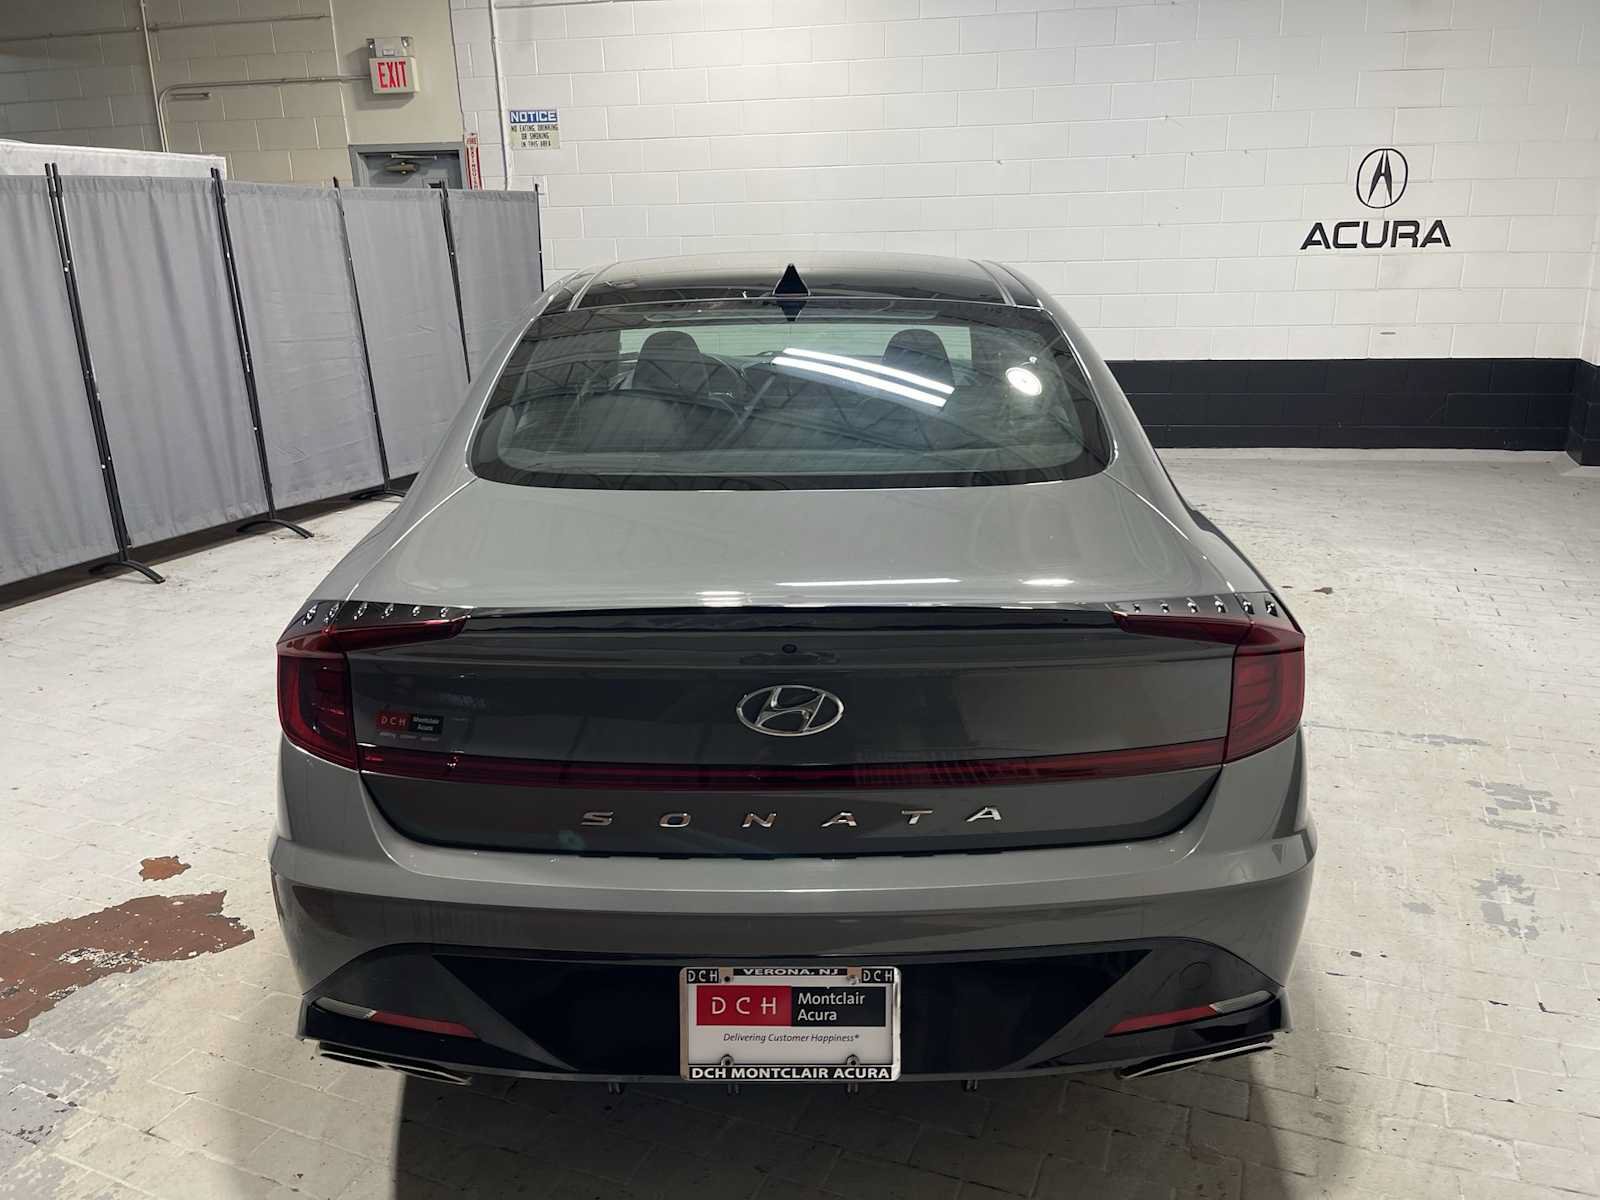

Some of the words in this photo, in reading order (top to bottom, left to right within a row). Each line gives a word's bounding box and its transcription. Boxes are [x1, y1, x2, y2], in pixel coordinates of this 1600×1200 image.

[377, 61, 407, 88] EXIT
[510, 111, 557, 122] NOTICE
[1300, 220, 1451, 249] ACURA
[581, 806, 1001, 828] SONATA
[688, 970, 718, 982] DCH
[819, 968, 839, 976] NJ
[863, 970, 893, 982] DCH
[798, 992, 865, 1005] Montclair
[711, 997, 777, 1015] DCH
[797, 1008, 838, 1021] Acura
[723, 1033, 766, 1044] Delivering
[768, 1033, 809, 1042] Customer
[692, 1068, 727, 1079] DCH
[730, 1068, 829, 1079] MONTCLAIR
[832, 1067, 890, 1079] ACURA
